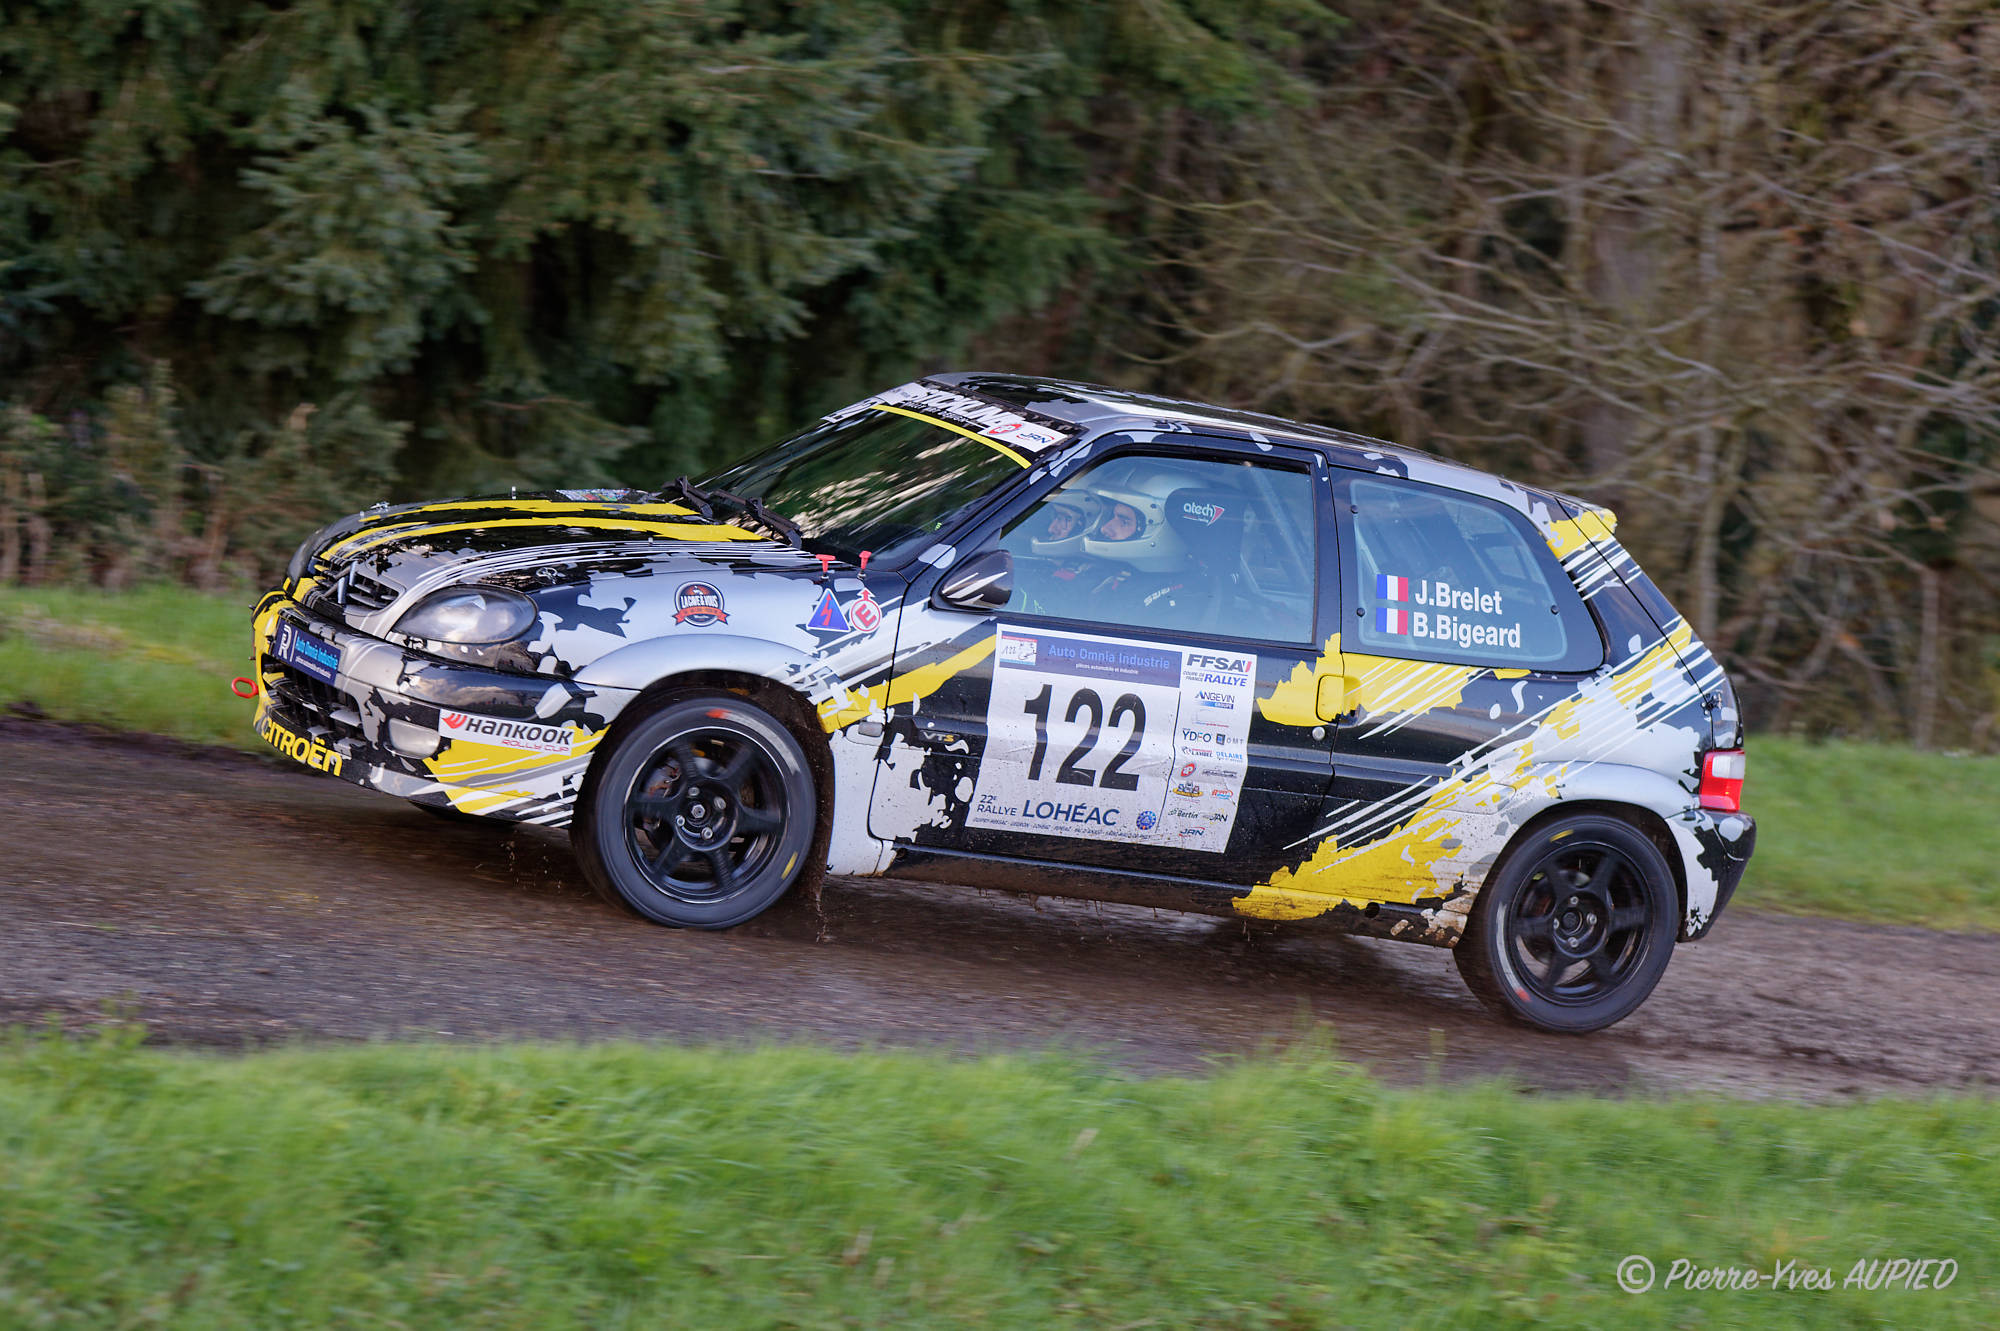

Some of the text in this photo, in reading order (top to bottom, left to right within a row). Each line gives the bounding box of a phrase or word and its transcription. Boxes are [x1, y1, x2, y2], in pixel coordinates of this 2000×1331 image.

[1415, 579, 1503, 615] J.Brelet
[855, 603, 877, 627] E
[1413, 611, 1521, 649] B.Bigeard
[1048, 645, 1170, 669] Auto Omnia Industrie
[1187, 654, 1244, 672] FFSA
[1204, 674, 1247, 686] RALLYE
[1195, 691, 1235, 703] ANGEVIN
[923, 731, 954, 742] VTS
[1024, 683, 1147, 792] 122
[544, 744, 569, 752] CUP
[977, 804, 1018, 816] RALLYE
[1022, 799, 1121, 826] LOHÉAC
